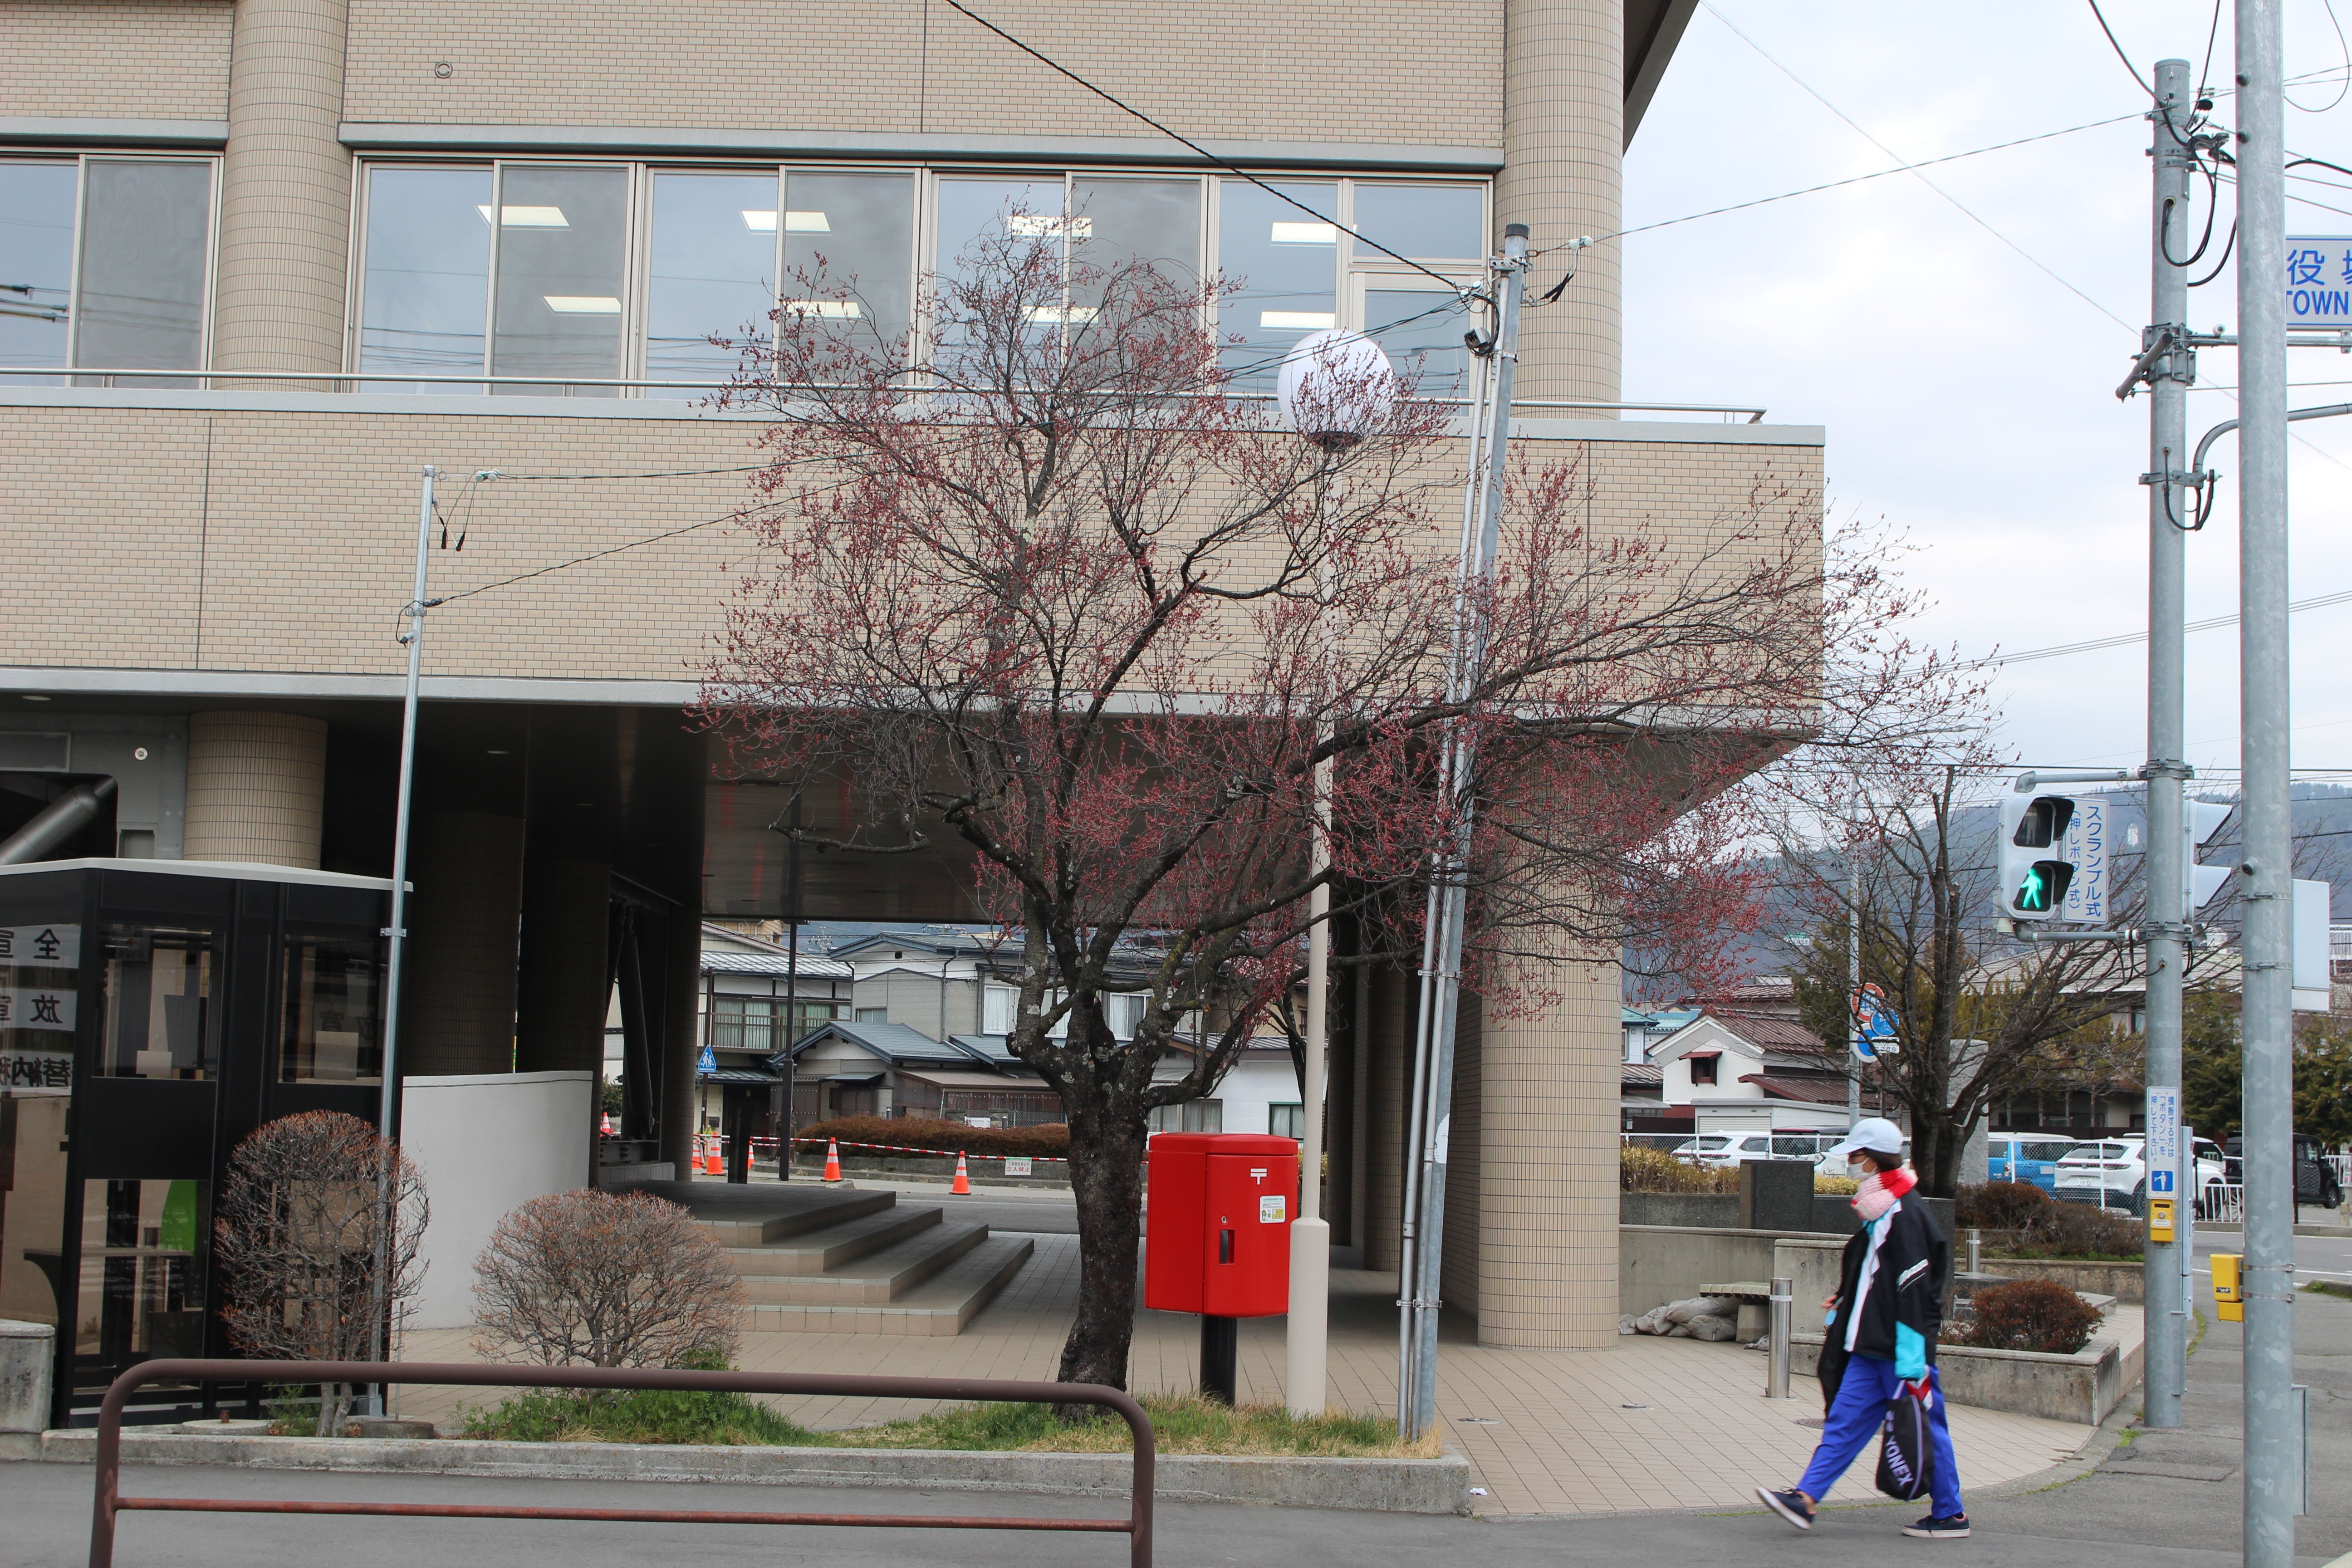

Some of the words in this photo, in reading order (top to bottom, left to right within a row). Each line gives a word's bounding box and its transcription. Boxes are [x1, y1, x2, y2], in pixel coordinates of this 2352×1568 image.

[2086, 806, 2102, 917] スクランブル式
[1885, 1435, 1914, 1488] YONEX
